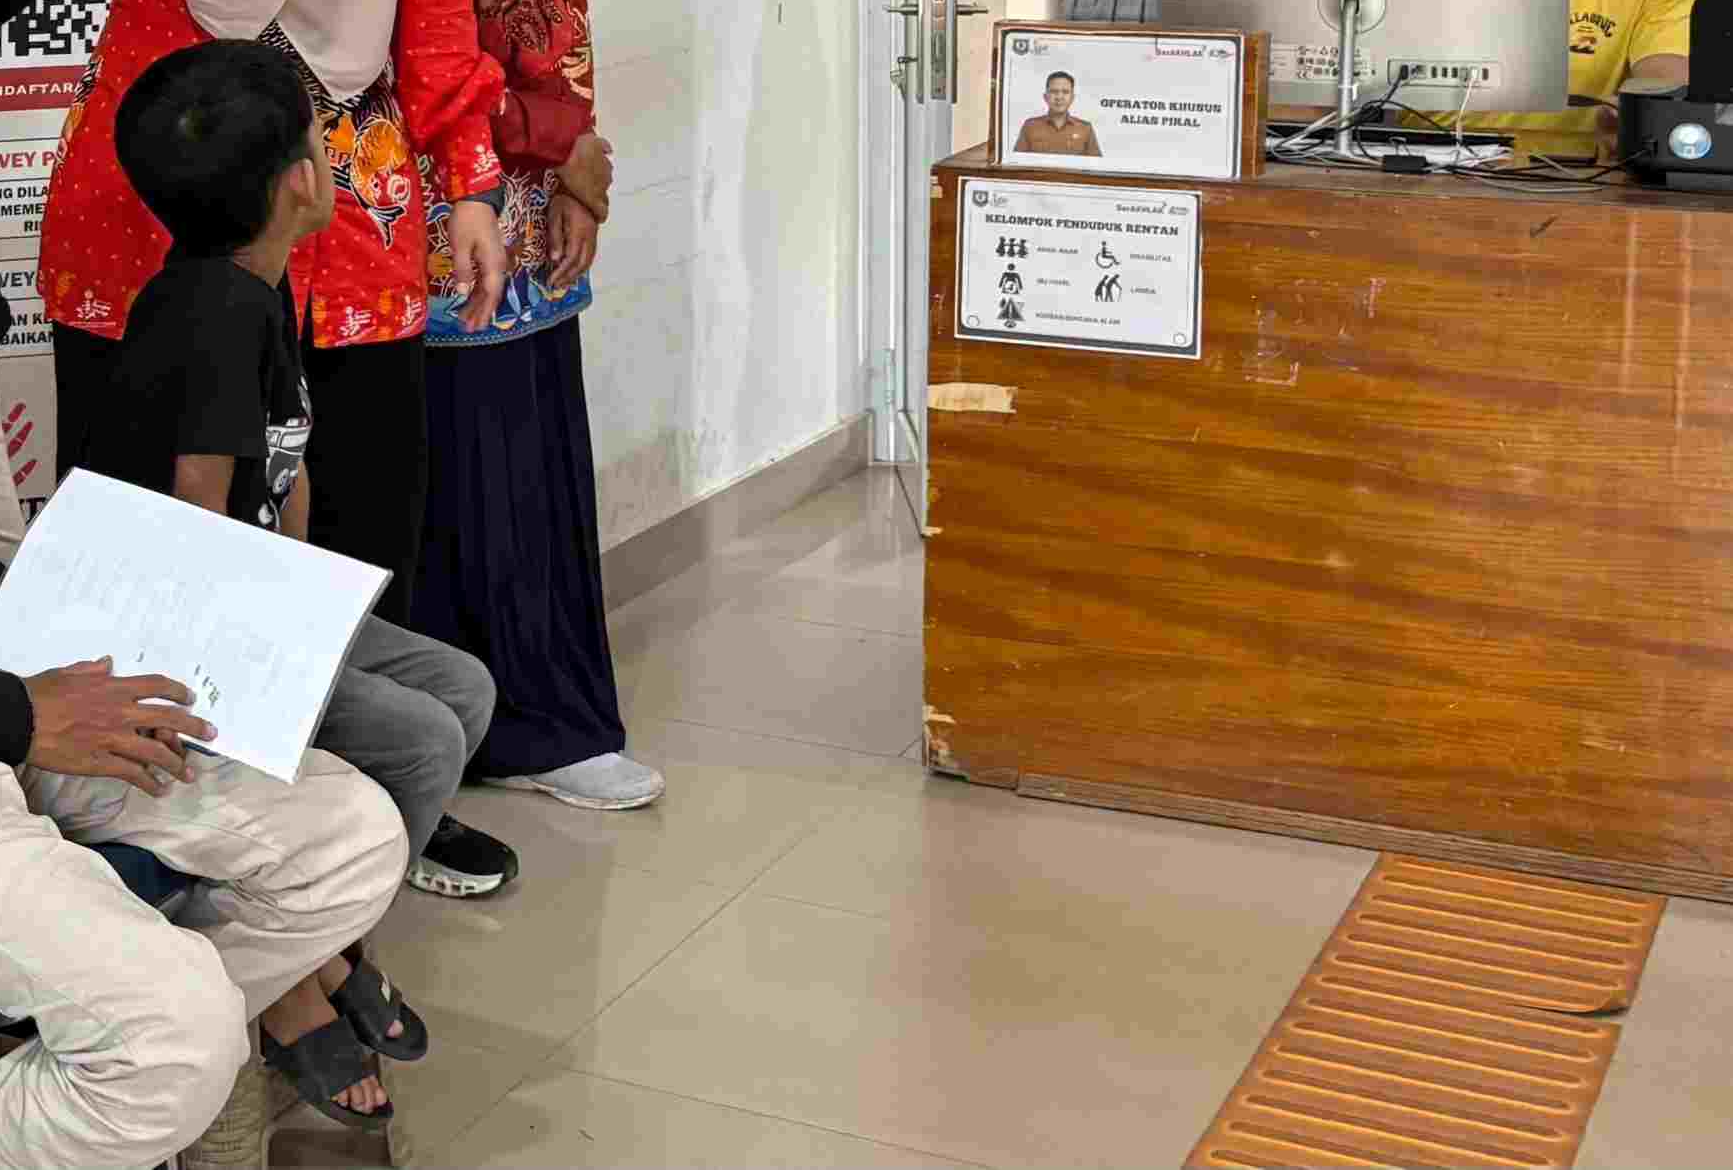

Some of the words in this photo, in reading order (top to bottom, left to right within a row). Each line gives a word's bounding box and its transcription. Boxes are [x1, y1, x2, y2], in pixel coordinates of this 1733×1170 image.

[1100, 98, 1166, 111] OPERATOR
[985, 214, 1053, 228] KELOMPOK
[1056, 219, 1122, 233] PENDUDUK
[1125, 223, 1179, 236] RENTAN
